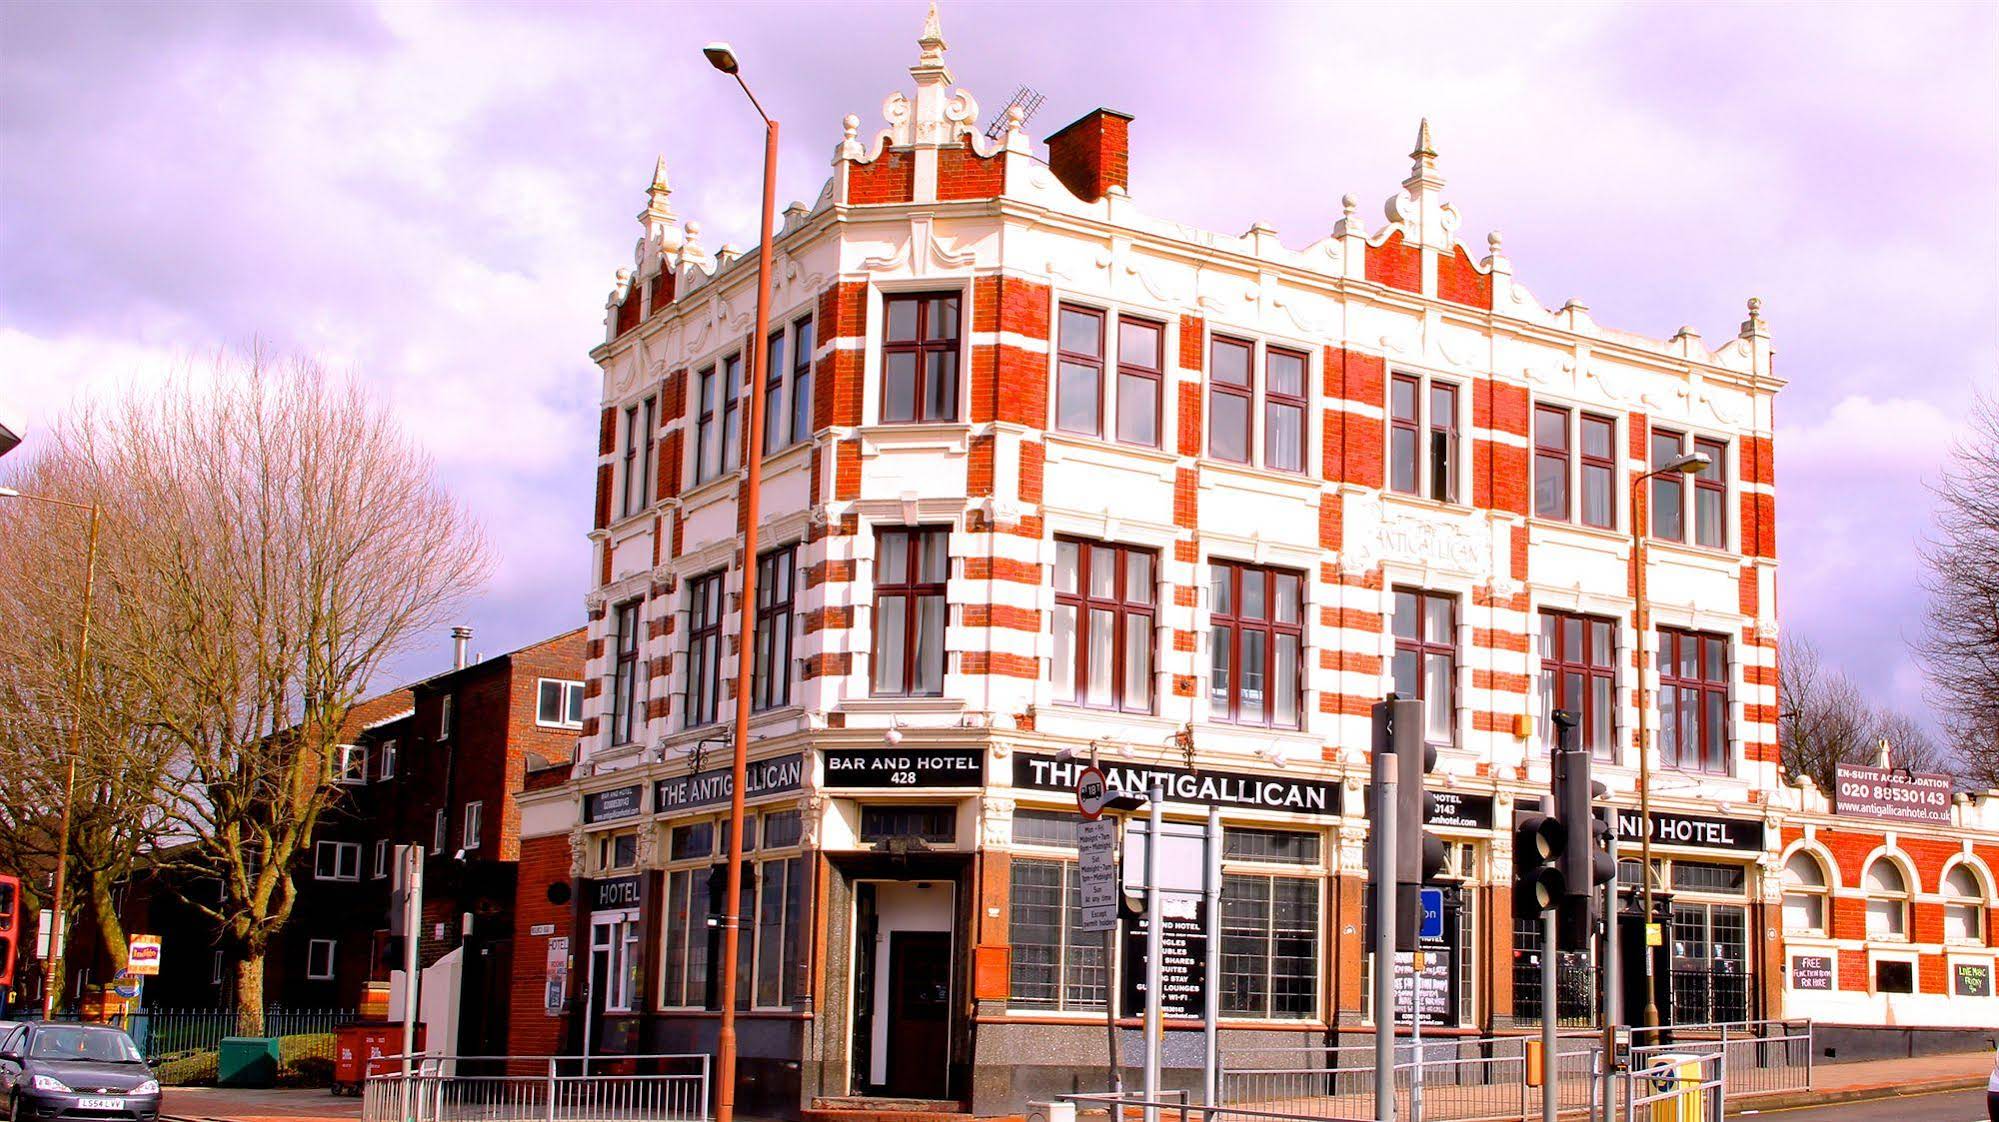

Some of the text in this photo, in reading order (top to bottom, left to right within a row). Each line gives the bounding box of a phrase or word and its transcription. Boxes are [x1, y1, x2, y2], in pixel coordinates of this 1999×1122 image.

[829, 757, 979, 769] BAR AND HOTEL
[660, 761, 801, 807] THE ANTIGLLICAN
[891, 772, 917, 784] 428
[1104, 767, 1327, 809] ANTIGALLICAN
[1841, 782, 1945, 806] 020 88530143
[1618, 815, 1735, 845] ND HOTEL
[600, 882, 640, 904] HOTEL
[1174, 922, 1201, 931] HOTEL
[1164, 957, 1195, 966] SHARES
[1802, 958, 1821, 968] FREE
[1164, 984, 1200, 993] LOUNGES
